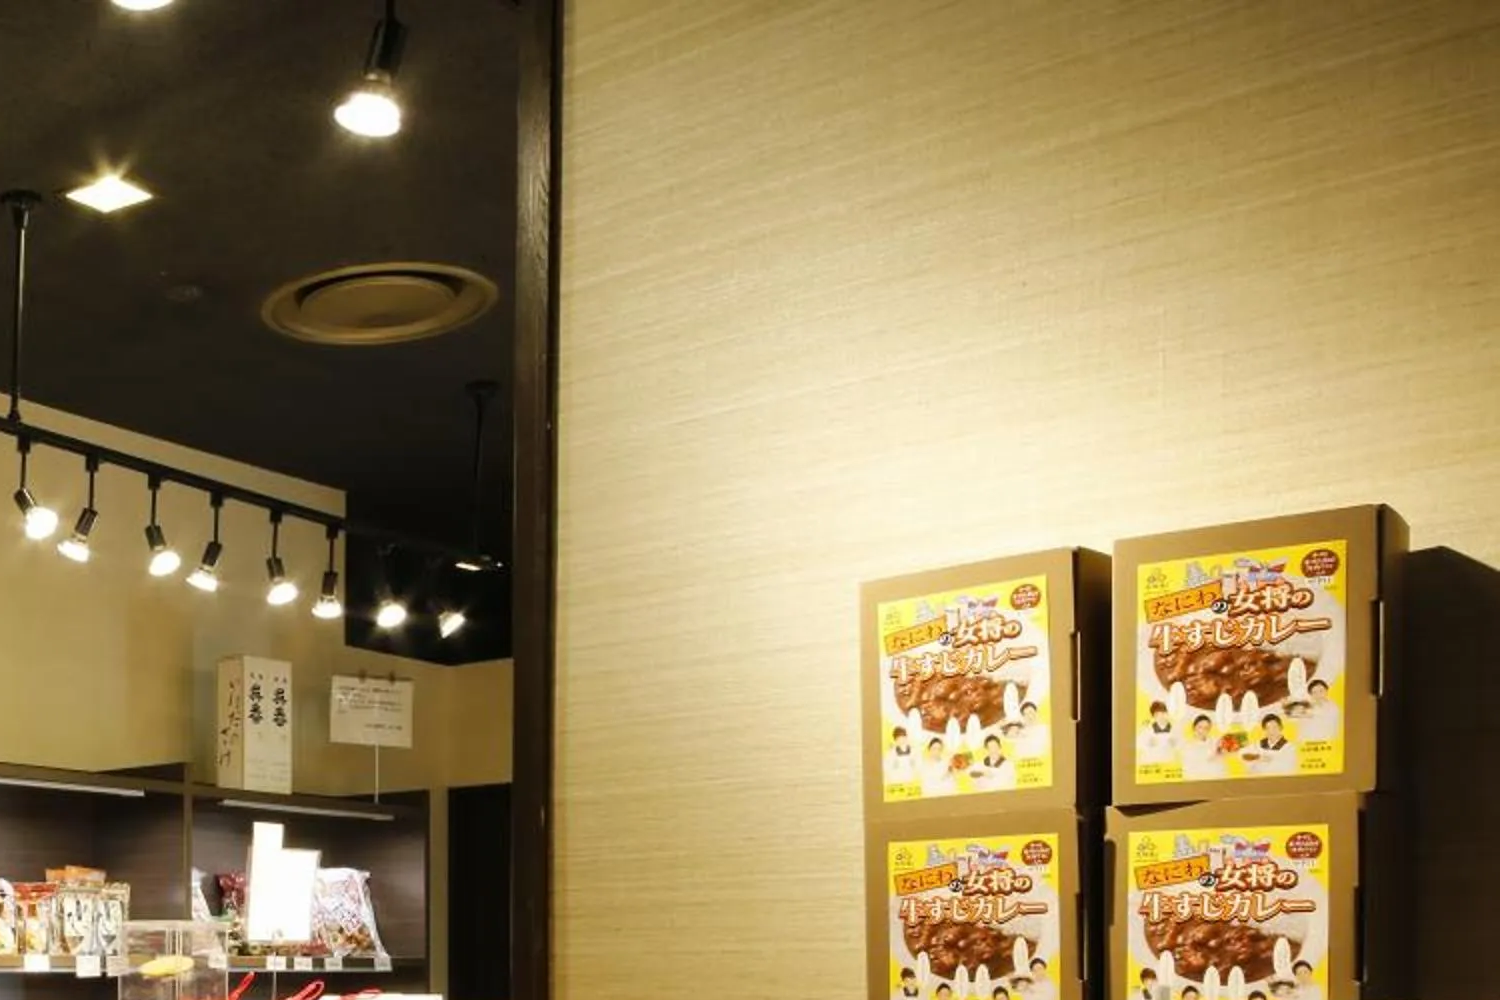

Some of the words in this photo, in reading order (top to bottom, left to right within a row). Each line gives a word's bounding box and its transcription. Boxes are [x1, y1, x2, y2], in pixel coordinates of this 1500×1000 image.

[1148, 615, 1332, 657] 牛すじカレー
[890, 642, 1038, 684] 牛すじカレー
[899, 896, 1048, 927] 牛すじカレー
[1139, 891, 1316, 923] 牛すじカレー
